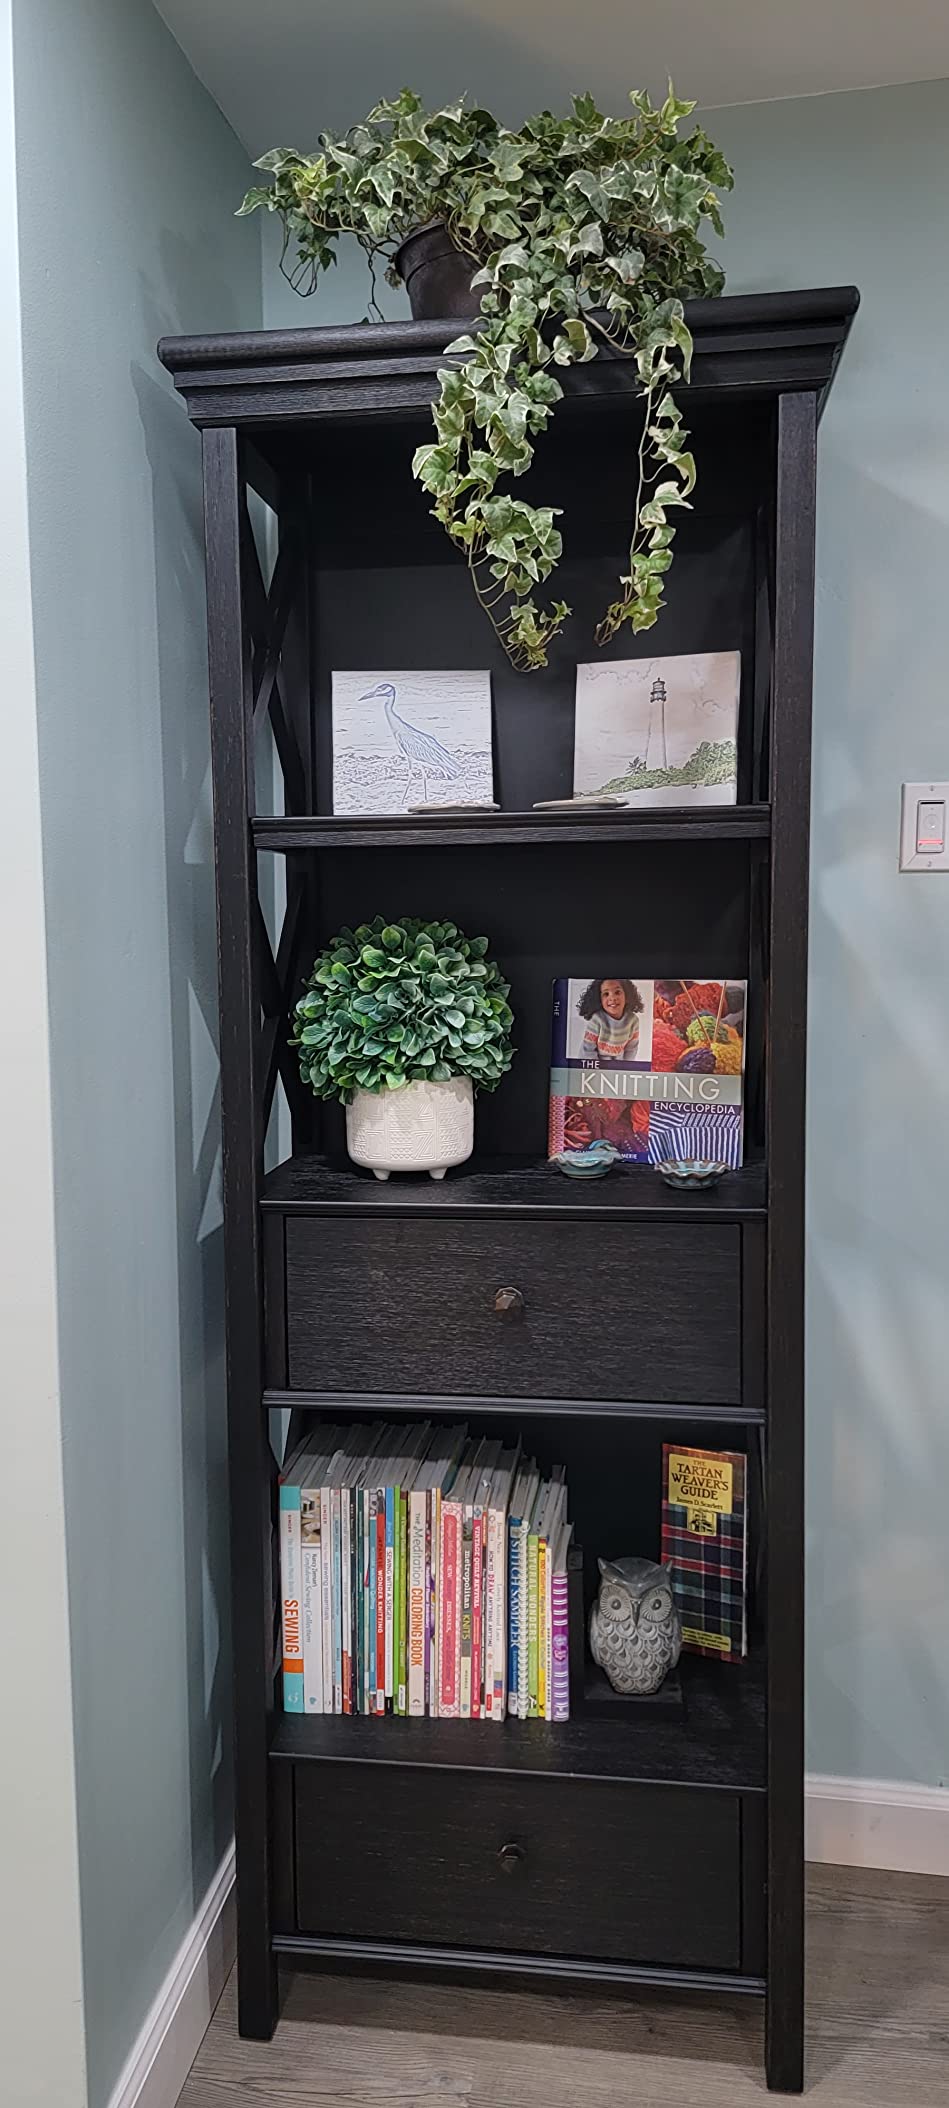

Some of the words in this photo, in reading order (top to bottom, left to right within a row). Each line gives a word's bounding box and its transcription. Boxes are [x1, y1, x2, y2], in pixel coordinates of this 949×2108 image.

[581, 1060, 600, 1069] THE
[581, 1072, 720, 1100] KNITTING
[654, 1102, 735, 1114] ENCYCLOPEDIA
[672, 1472, 729, 1491] WEAVER'S
[677, 1463, 723, 1479] TARTAN
[681, 1485, 718, 1500] GUIDE
[413, 1526, 423, 1586] Meditation
[510, 1540, 521, 1586] STITCH
[528, 1545, 537, 1590] NATURAL
[463, 1550, 472, 1609] metropolitan
[488, 1573, 496, 1594] DRAW
[304, 1585, 312, 1608] Sewing
[305, 1609, 313, 1642] Collection
[411, 1587, 423, 1637] COLORING
[510, 1588, 521, 1648] SAMPLER
[528, 1594, 537, 1643] WONDERS
[284, 1600, 299, 1653] SEWING
[462, 1614, 471, 1640] KNITS
[410, 1639, 423, 1666] BOOK
